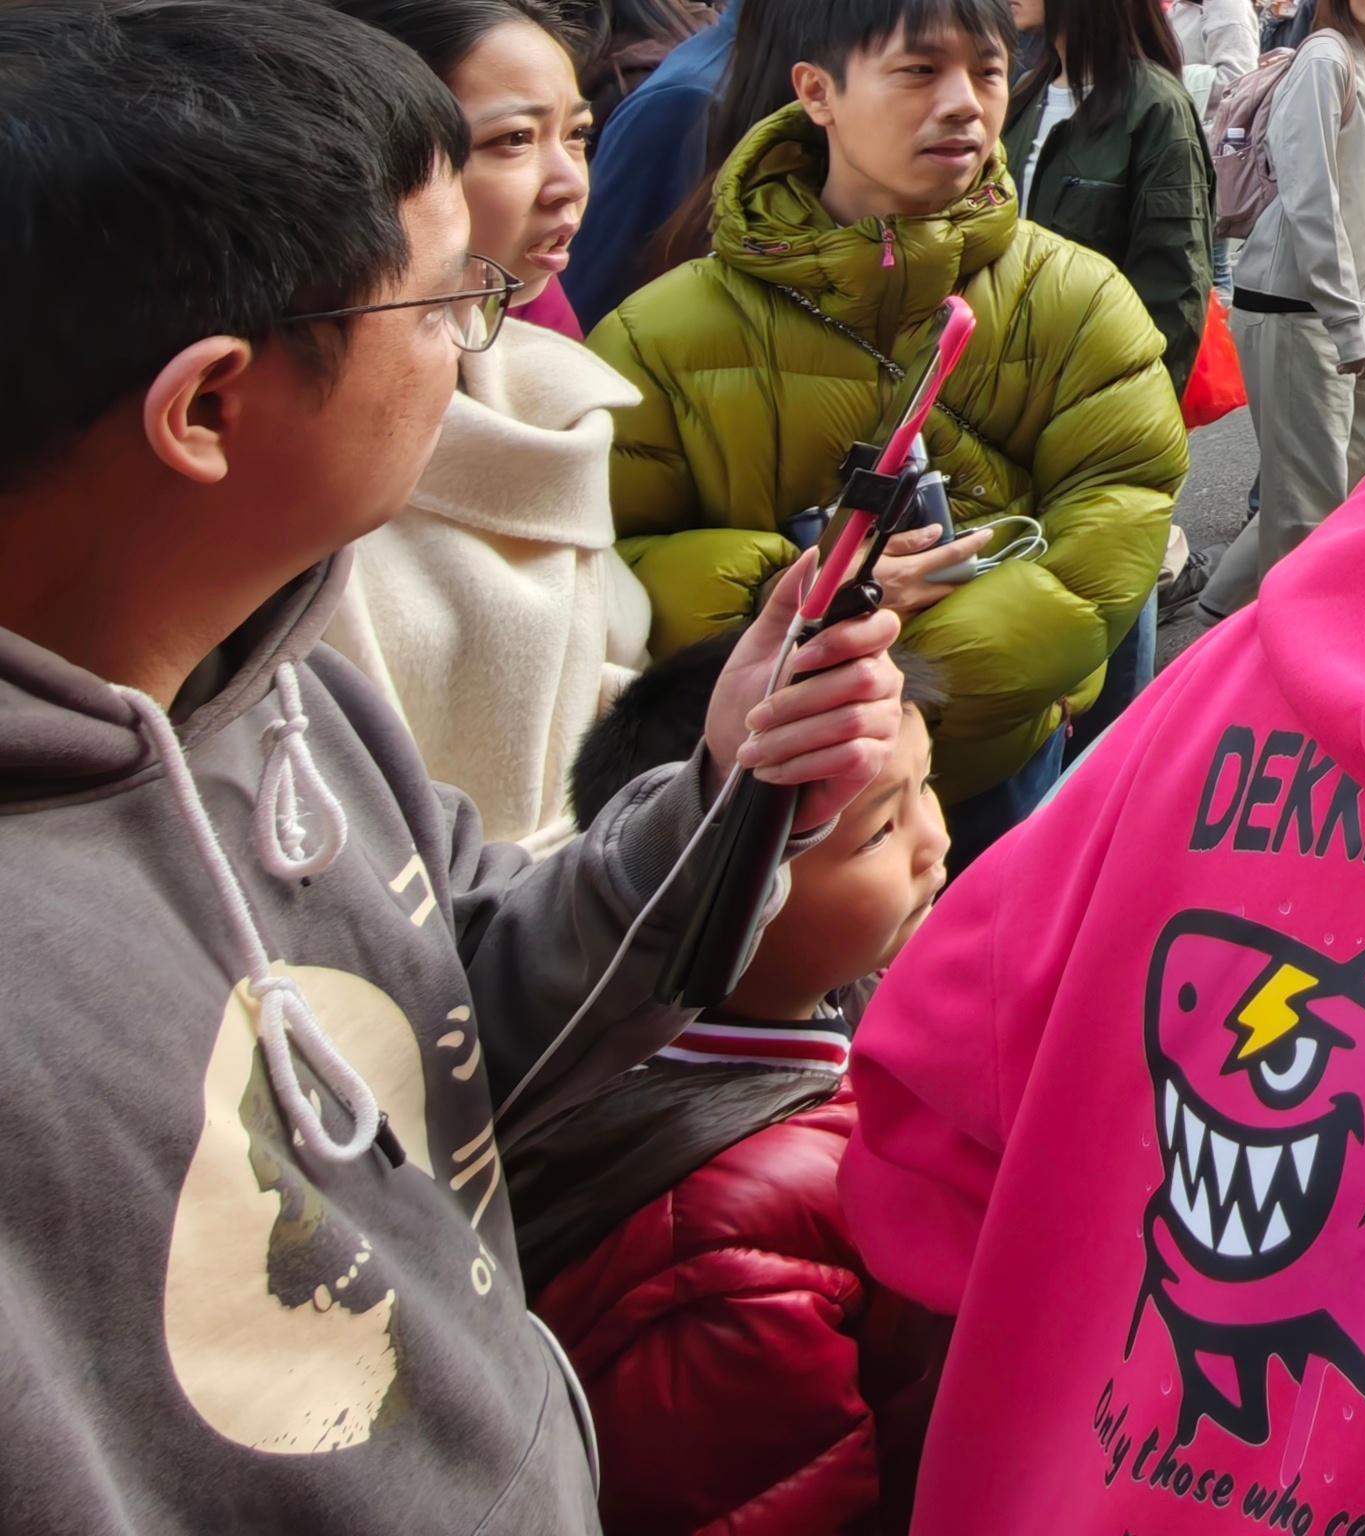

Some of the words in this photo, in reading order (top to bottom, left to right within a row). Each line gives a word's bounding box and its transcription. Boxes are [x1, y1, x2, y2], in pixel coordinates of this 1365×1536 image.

[1093, 1377, 1133, 1488] Only
[1131, 1426, 1235, 1508] those
[1242, 1473, 1314, 1536] who
